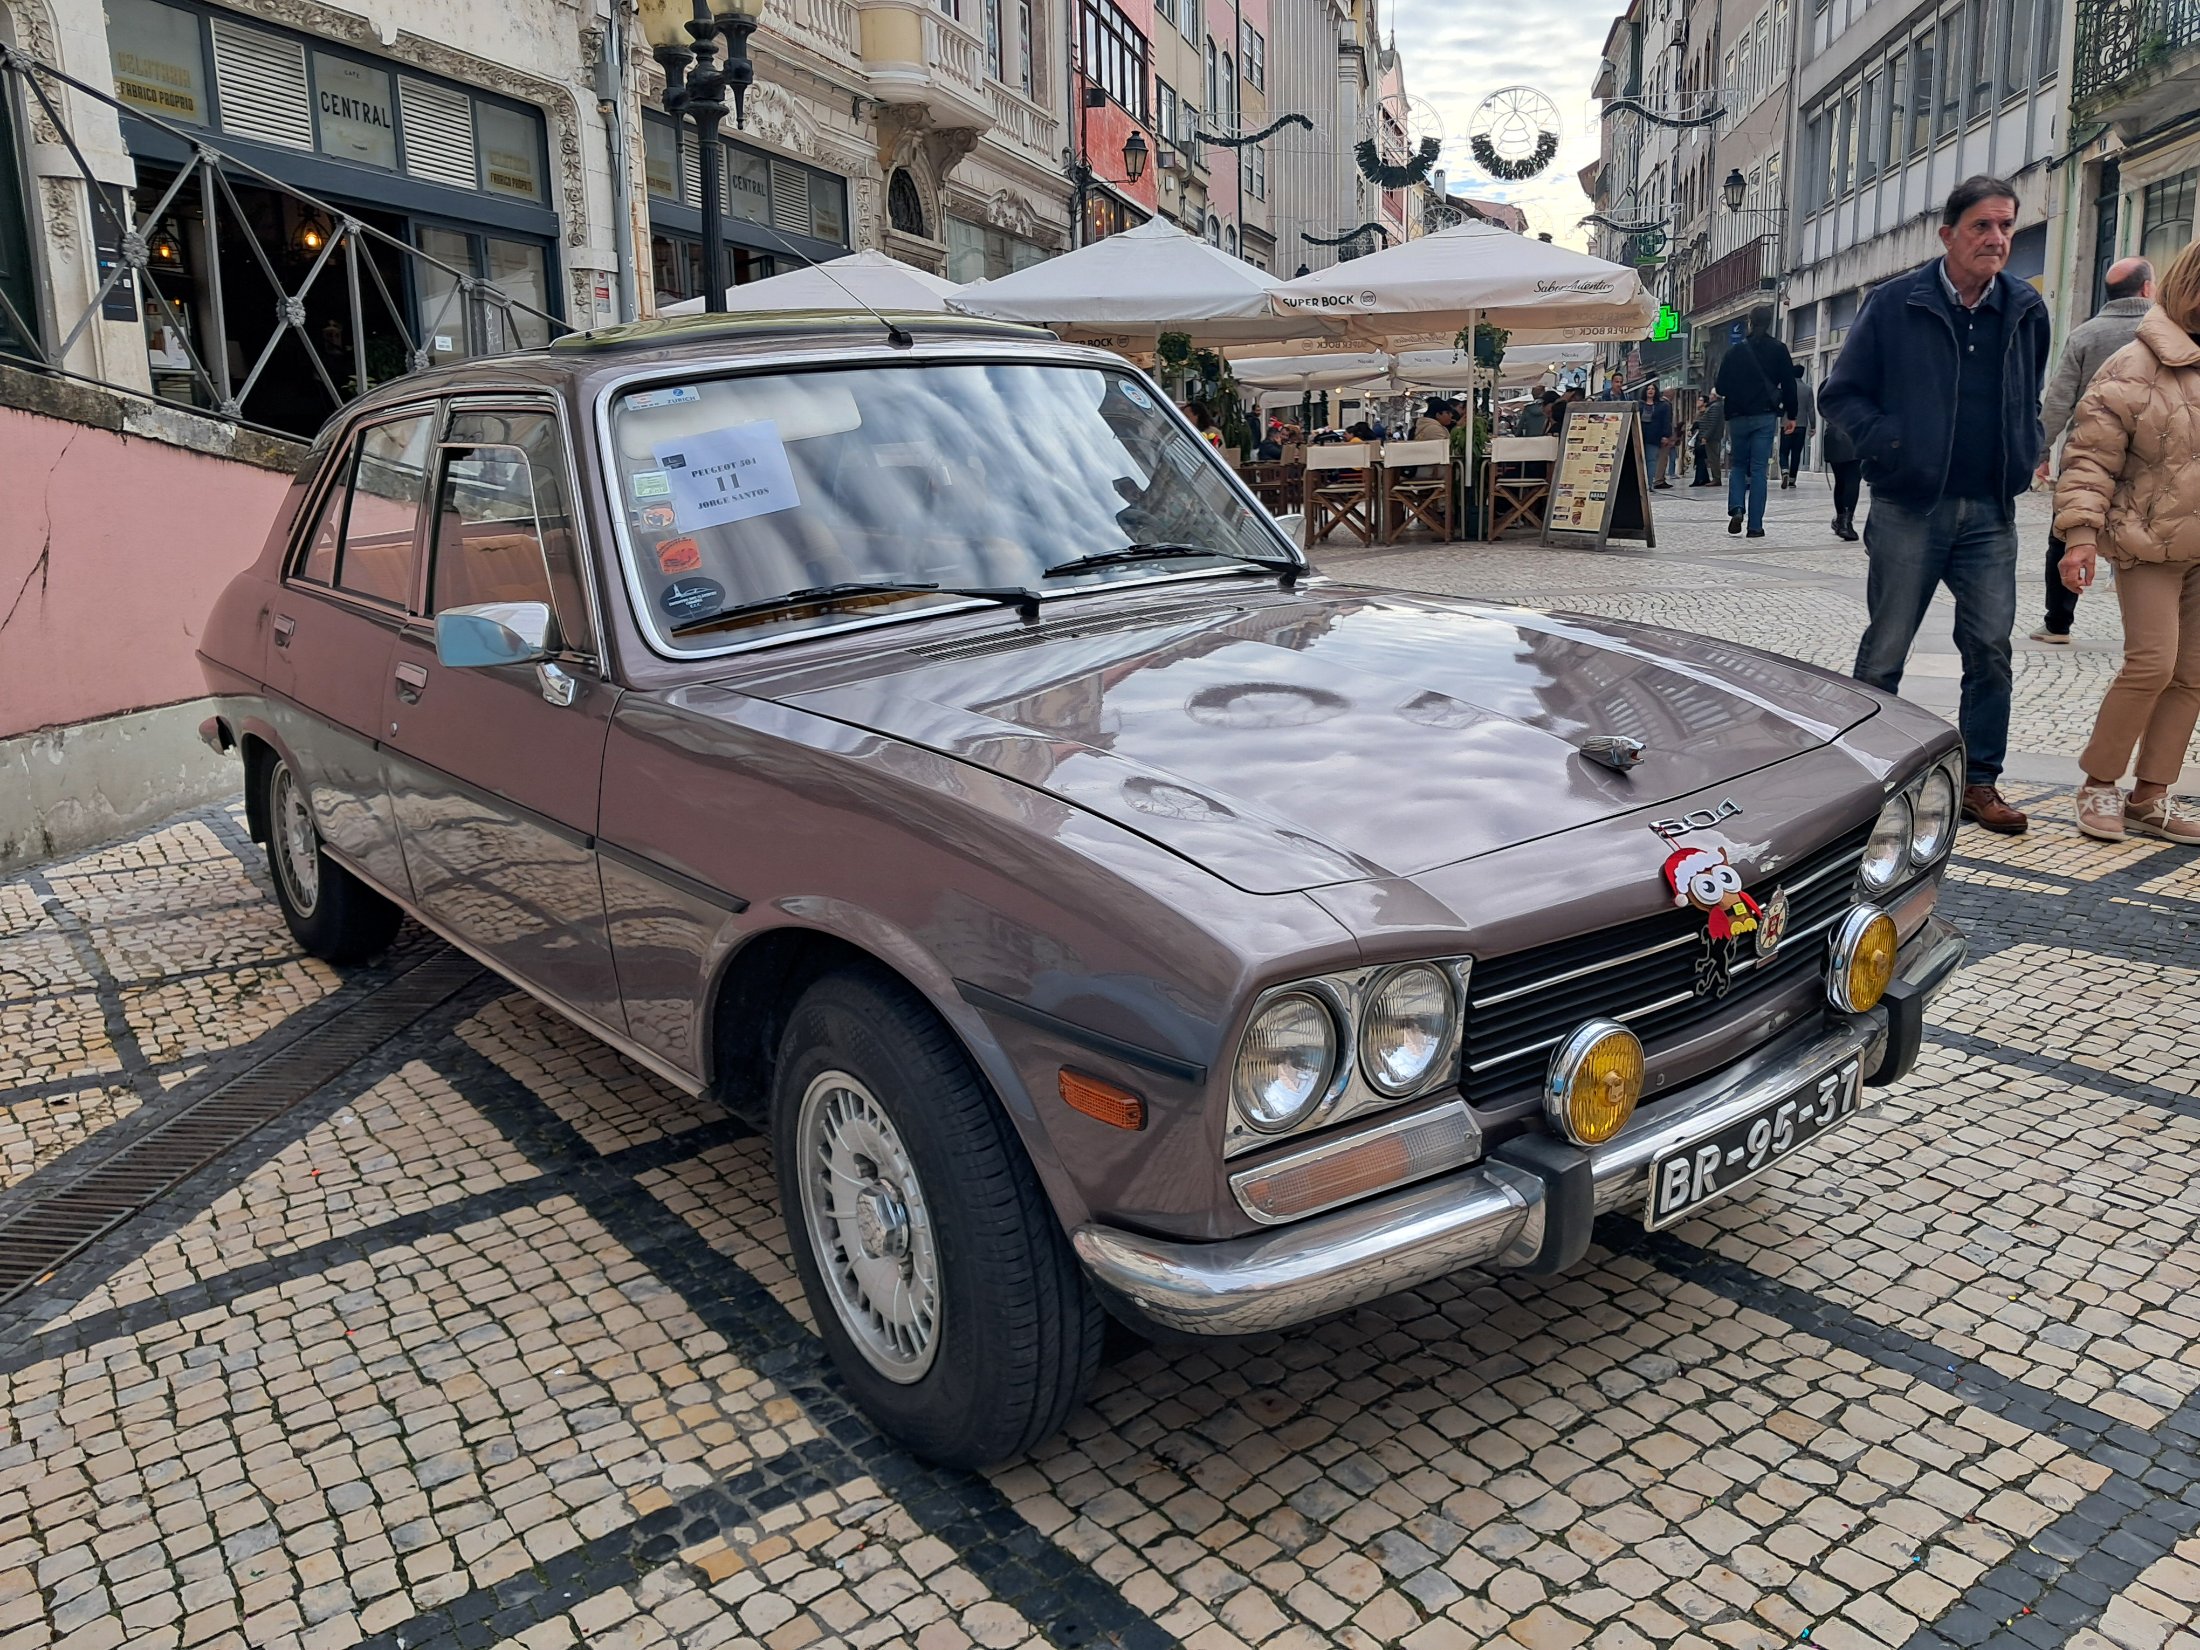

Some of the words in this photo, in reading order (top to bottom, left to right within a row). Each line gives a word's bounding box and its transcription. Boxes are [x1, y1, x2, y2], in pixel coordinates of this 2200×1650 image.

[120, 82, 157, 103] FABRICO
[320, 91, 391, 129] CENTRAL
[732, 174, 767, 197] CENTRAL
[1533, 279, 1566, 293] Sabor
[1283, 297, 1319, 308] SUPER
[1322, 295, 1354, 307] BOCK
[1088, 338, 1113, 347] BOCK
[667, 395, 696, 404] ZURICH
[691, 462, 737, 478] PEUGEOT
[739, 457, 757, 467] 504
[717, 473, 740, 492] 11
[698, 497, 729, 510] JORGE
[729, 487, 770, 502] SANTOS
[1649, 797, 1743, 838] 504
[1659, 1060, 1859, 1214] BR-95-31
